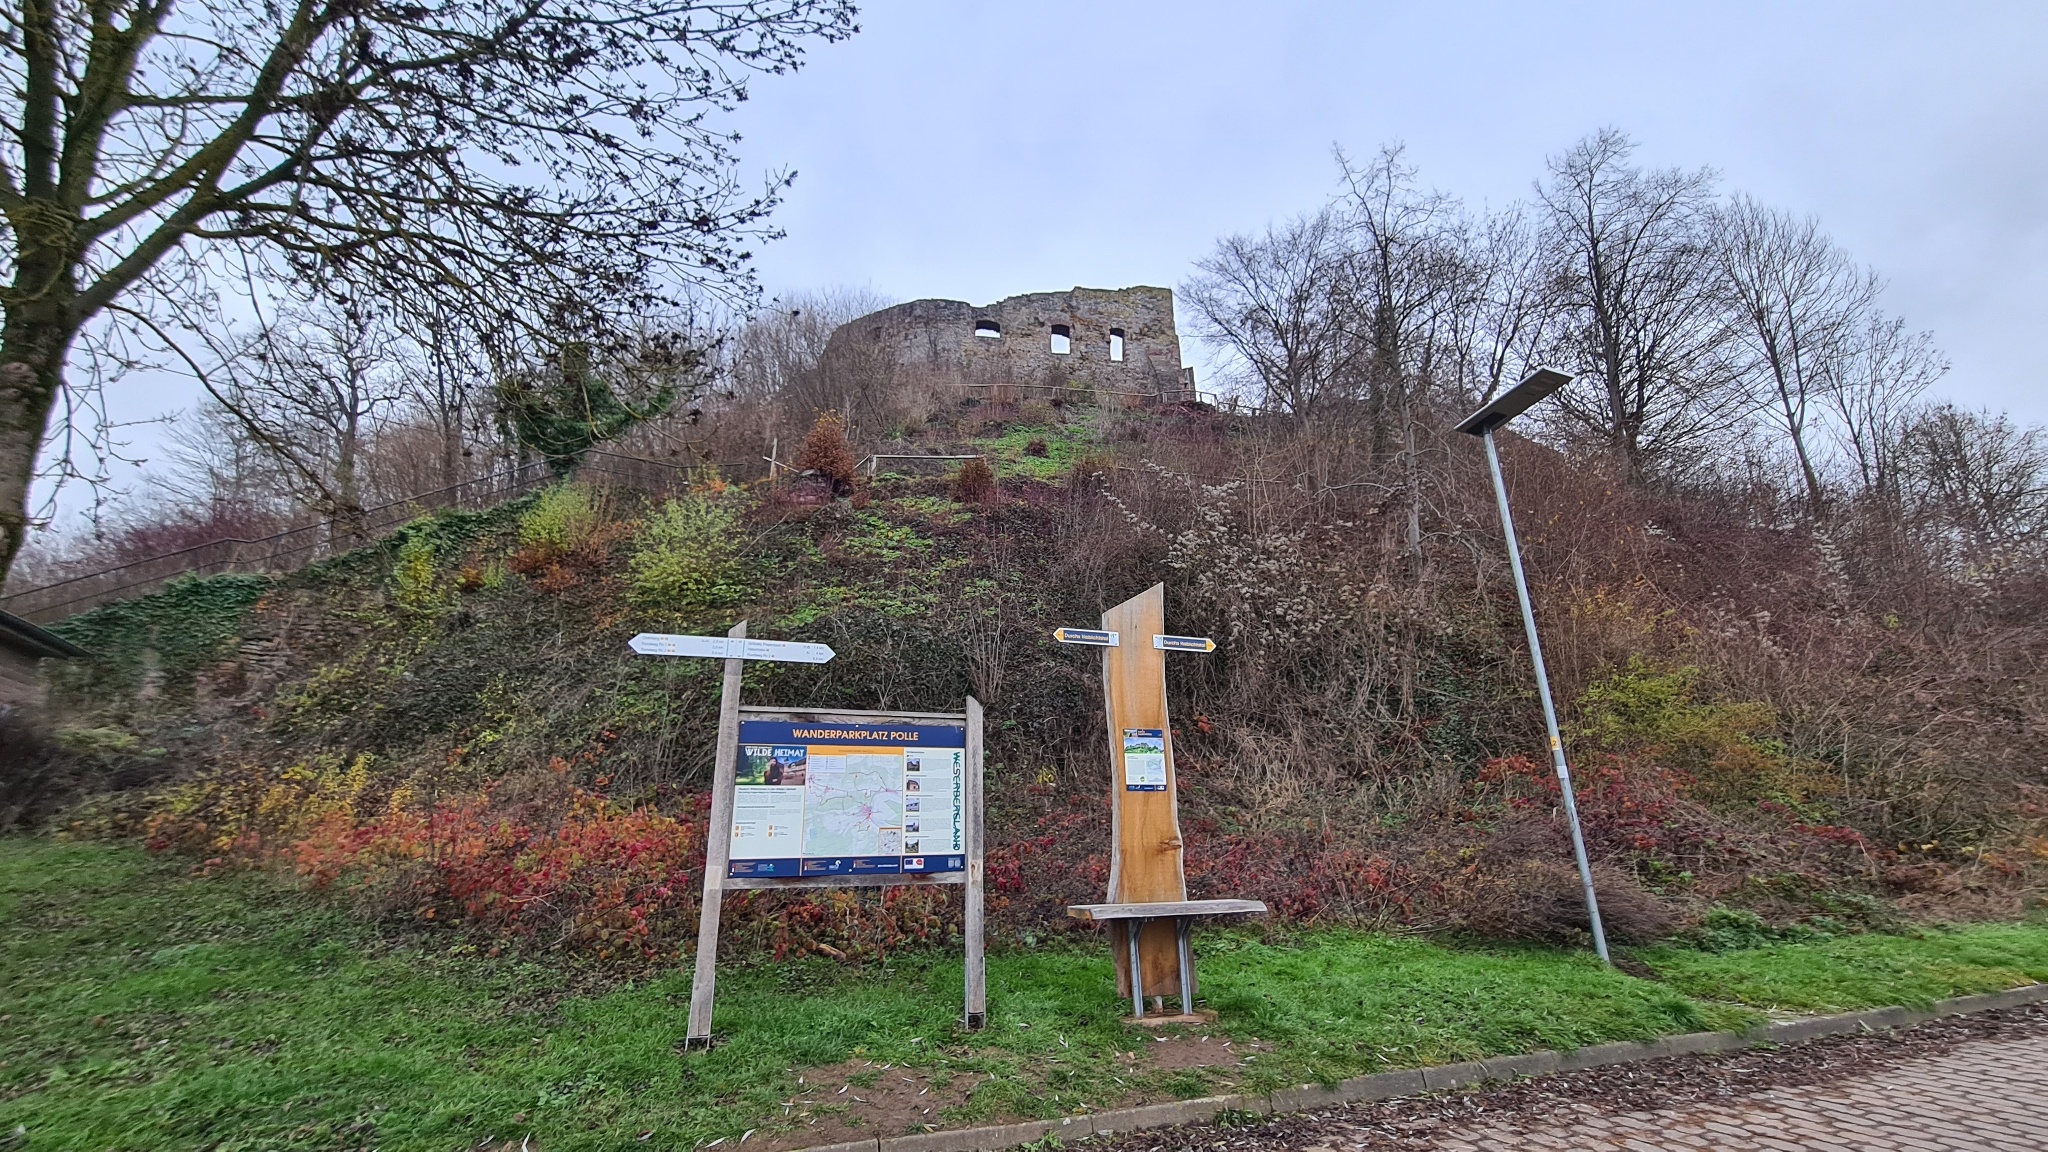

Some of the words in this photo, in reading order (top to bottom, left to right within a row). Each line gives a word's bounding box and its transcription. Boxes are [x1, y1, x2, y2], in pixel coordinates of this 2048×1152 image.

[792, 729, 888, 740] WANDERPARKPLATZ
[890, 731, 919, 741] POLLE
[745, 748, 772, 757] WILDE
[773, 748, 805, 757] HEIMAT
[953, 751, 961, 851] WESERBERGLAND
